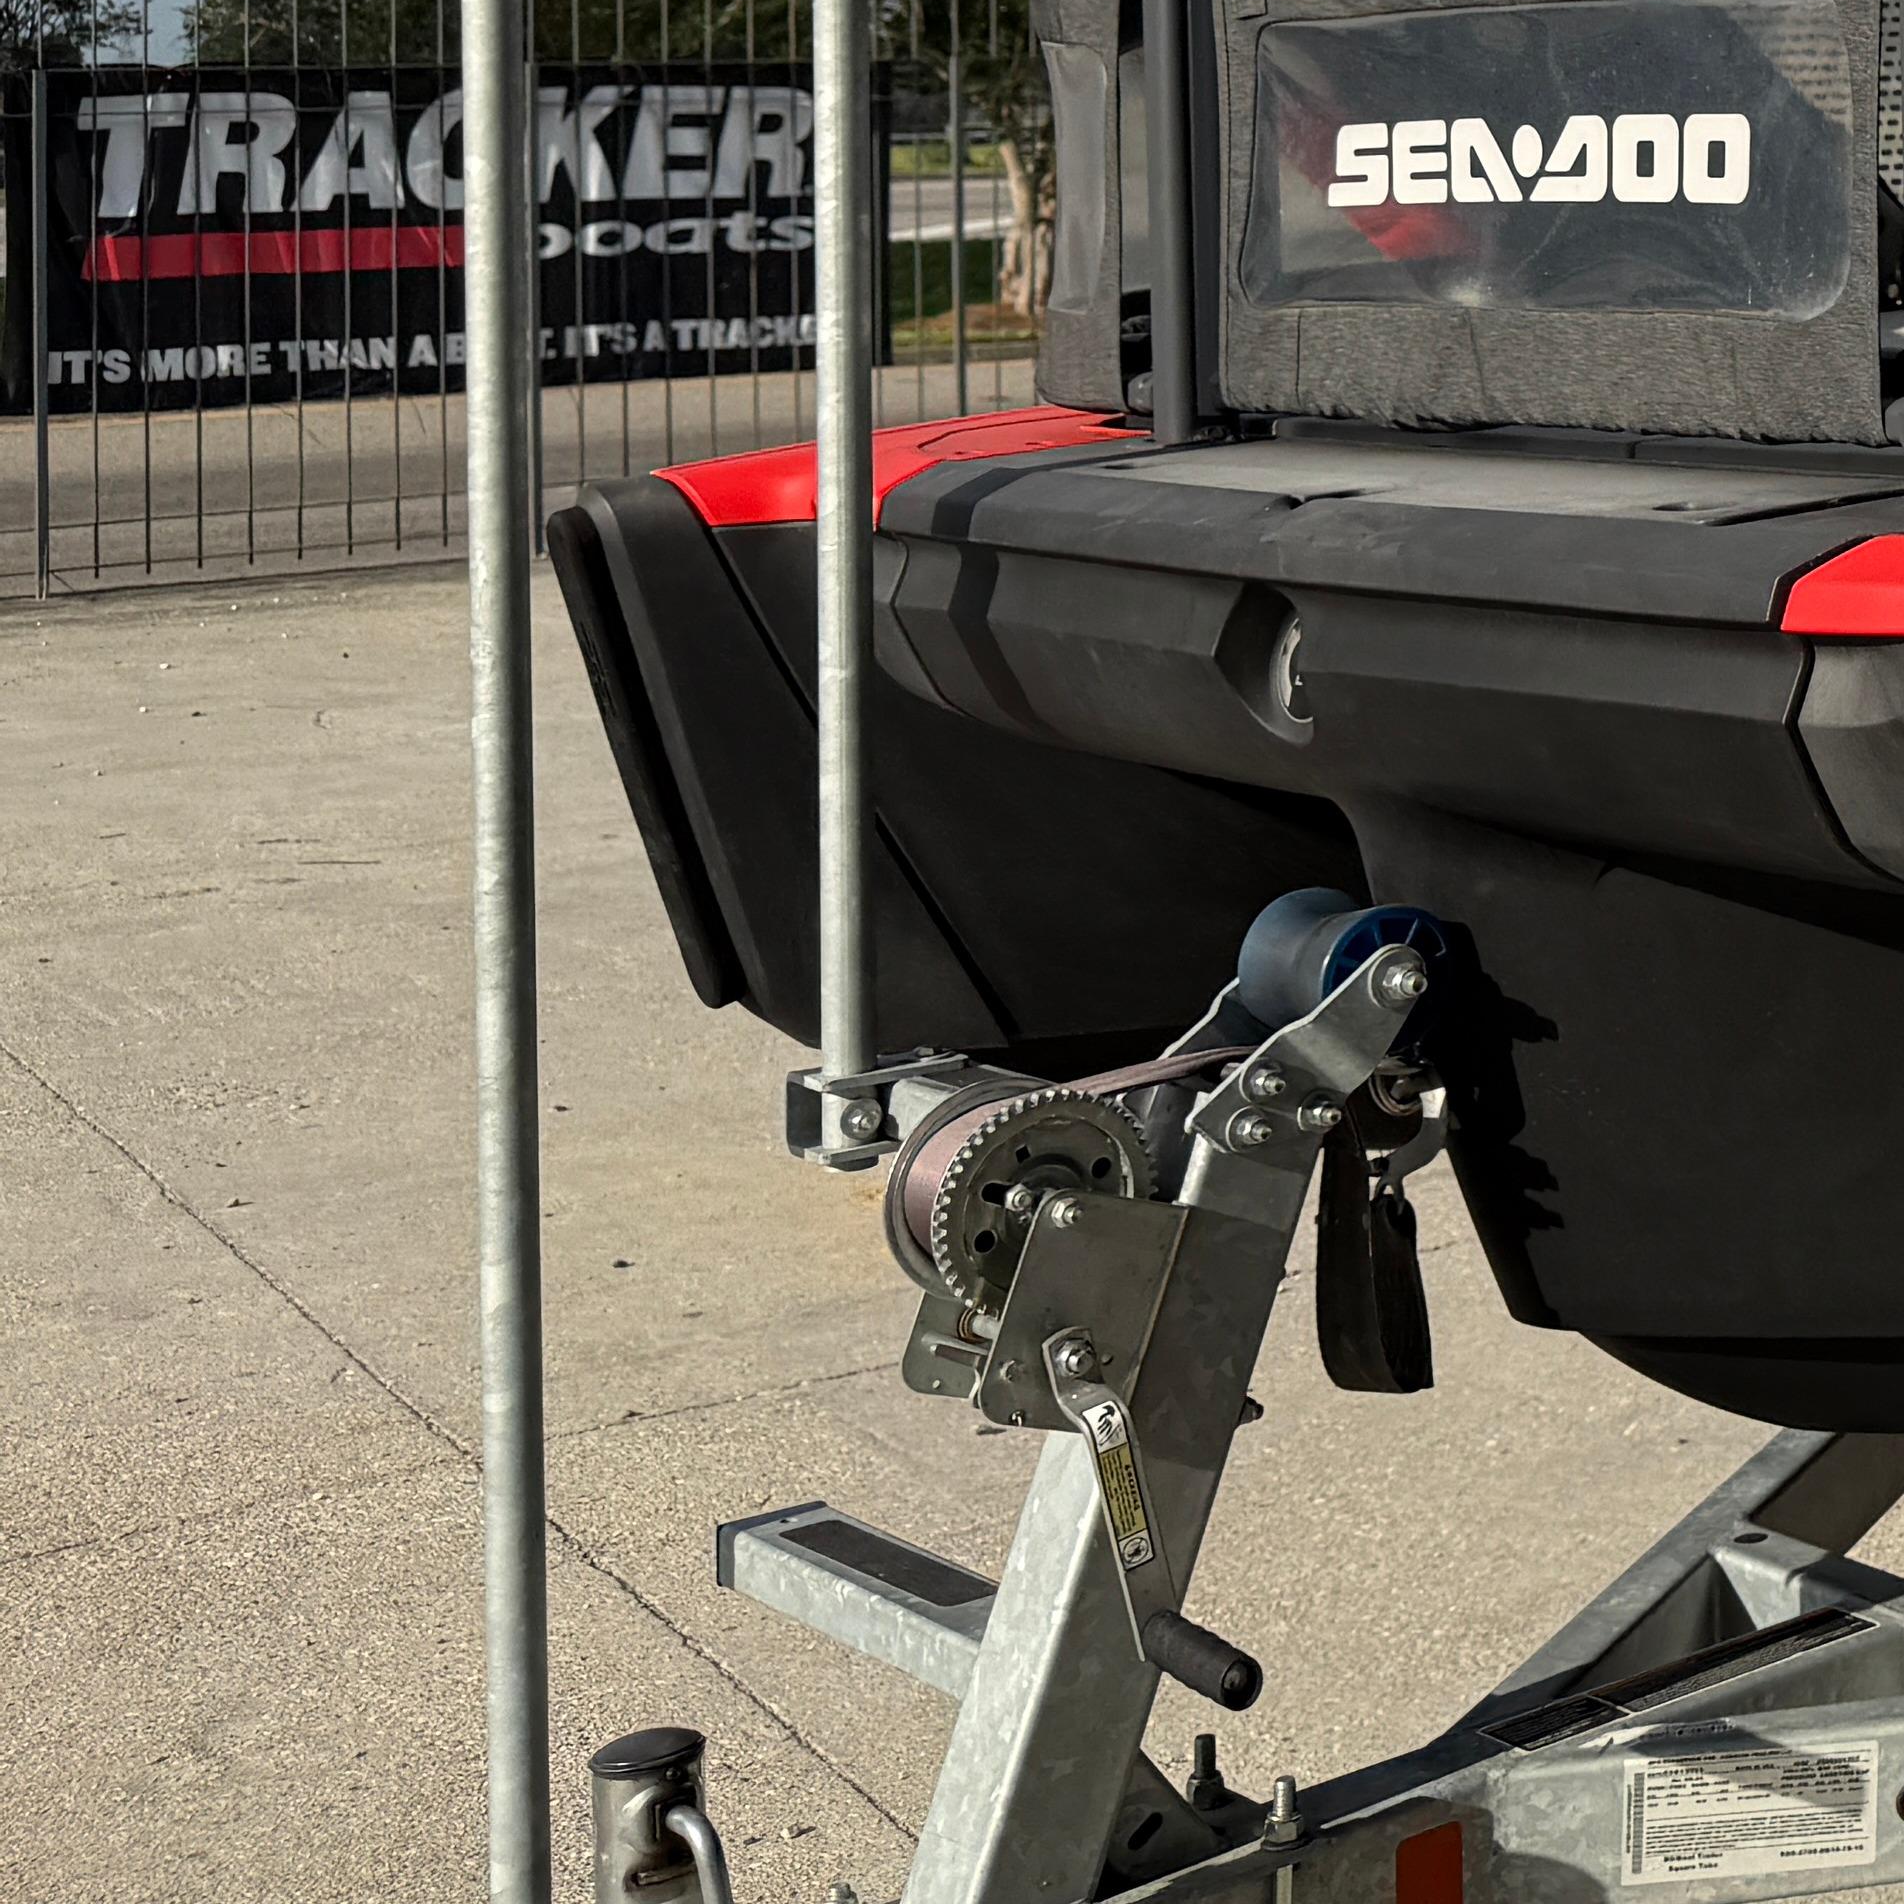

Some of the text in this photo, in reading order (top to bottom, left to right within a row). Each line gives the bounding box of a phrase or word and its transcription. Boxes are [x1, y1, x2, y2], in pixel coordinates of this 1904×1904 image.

[141, 342, 271, 382] MORE
[279, 336, 396, 373] THAN
[407, 333, 437, 368] A
[563, 323, 637, 359] IT'S
[643, 320, 665, 352] A
